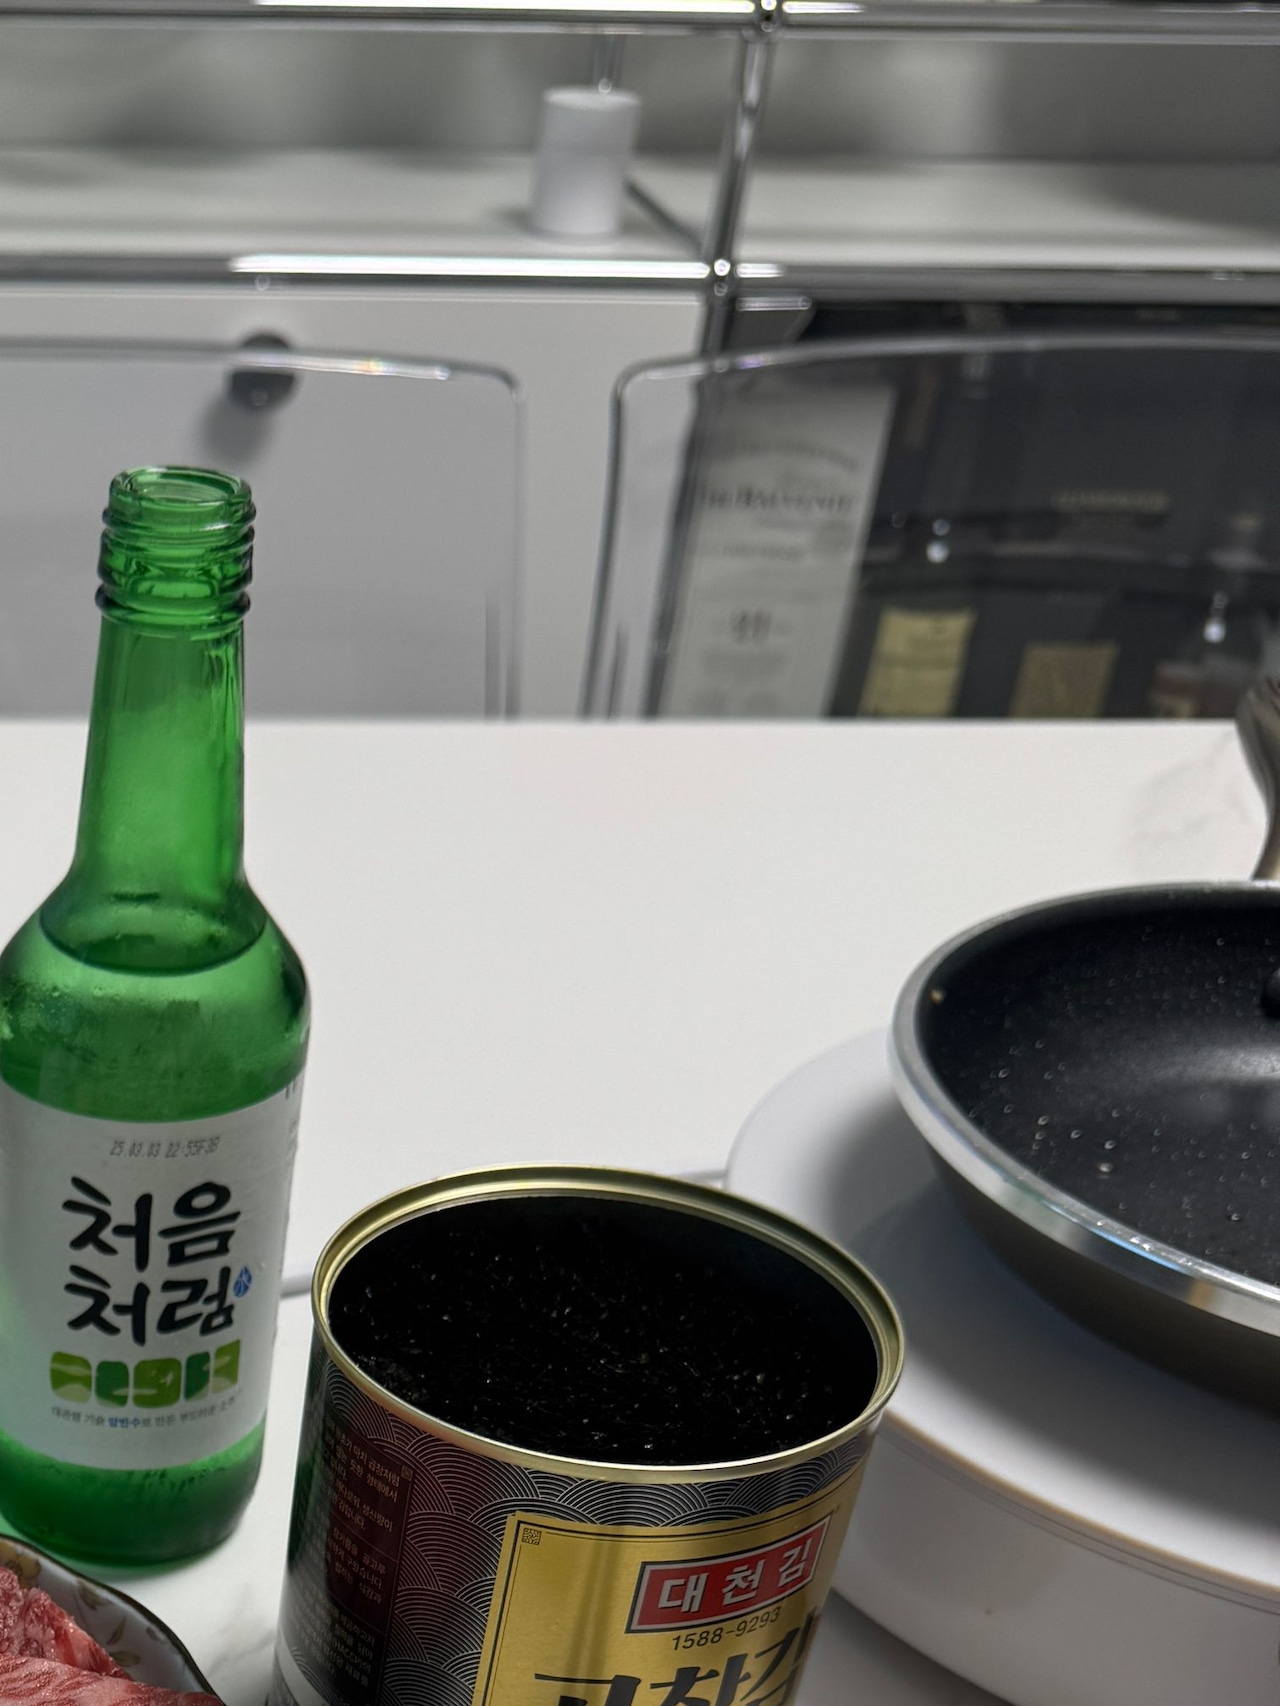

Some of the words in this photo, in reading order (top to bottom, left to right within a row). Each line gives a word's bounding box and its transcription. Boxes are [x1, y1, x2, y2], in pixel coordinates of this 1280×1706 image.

[62, 1176, 241, 1272] 처음
[64, 1265, 235, 1347] 처럼
[657, 1537, 812, 1613] 대천김
[671, 1604, 782, 1651] 1588-9293
